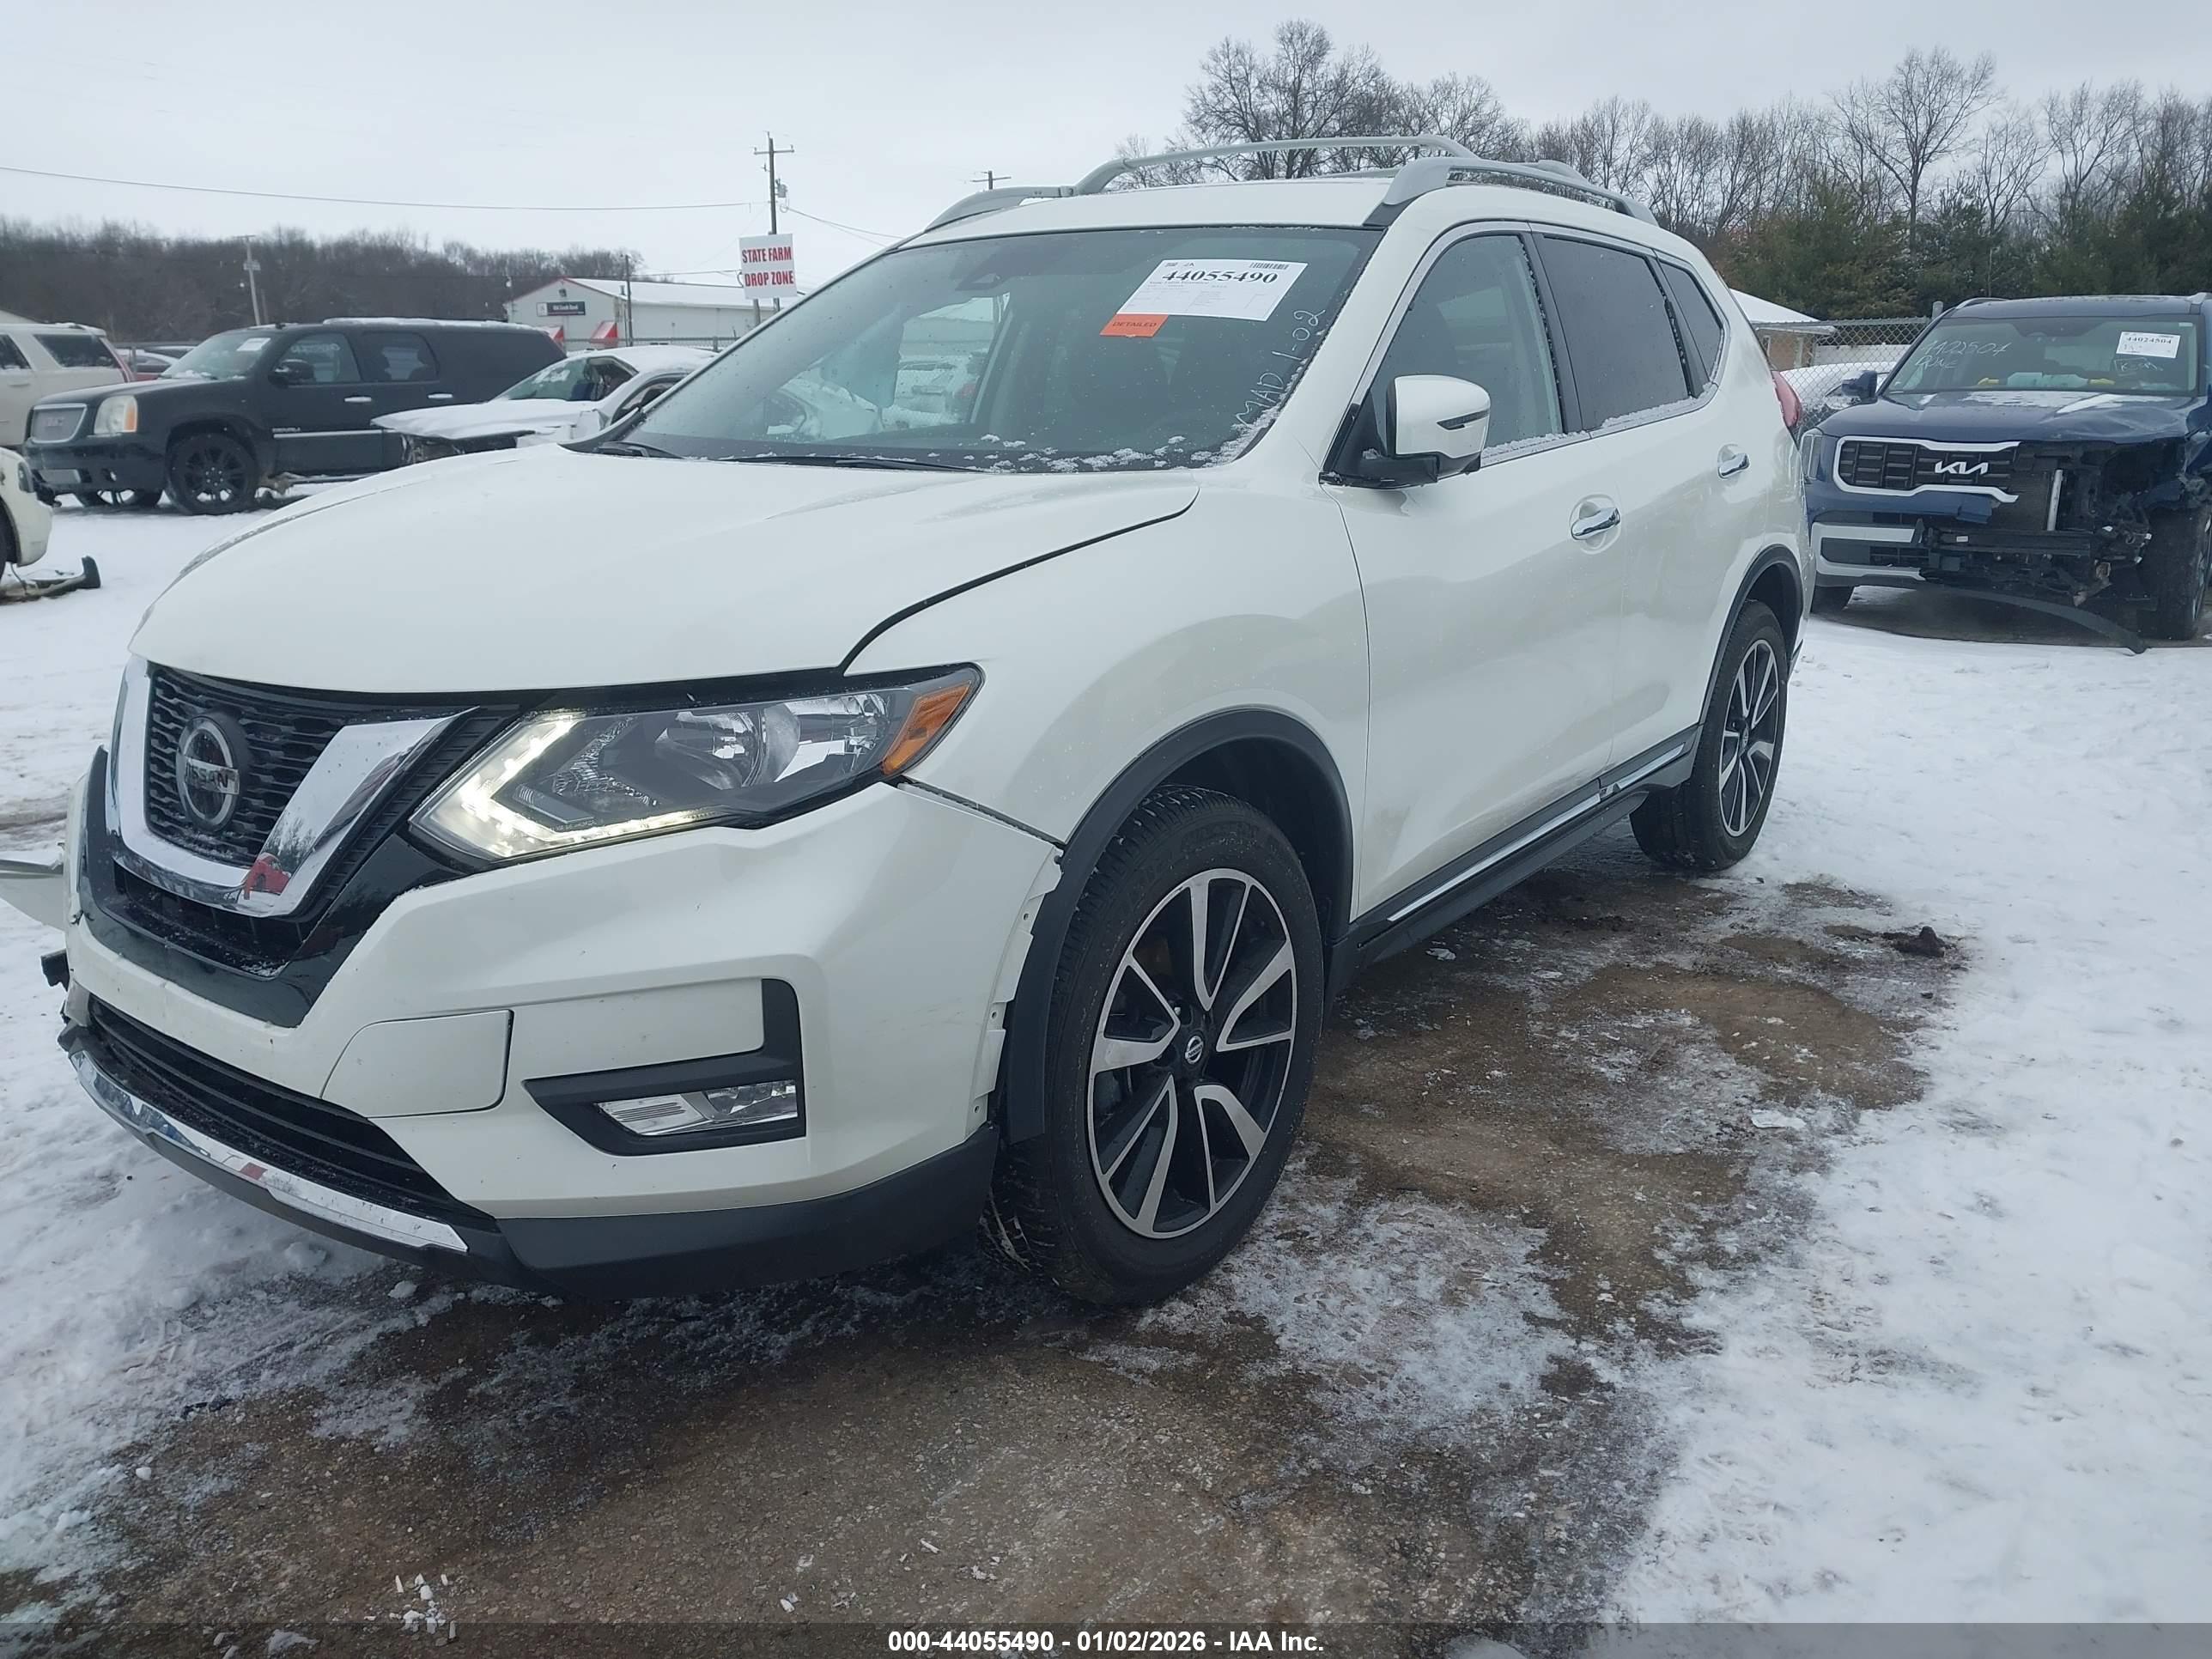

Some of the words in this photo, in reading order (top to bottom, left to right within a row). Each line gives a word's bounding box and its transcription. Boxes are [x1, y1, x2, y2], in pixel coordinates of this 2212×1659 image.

[742, 248, 767, 264] STATE
[769, 246, 792, 261] FARM
[744, 272, 769, 287] DROP
[771, 270, 794, 285] ZONE
[1162, 270, 1279, 284] 44055490
[1935, 461, 1989, 475] KIA
